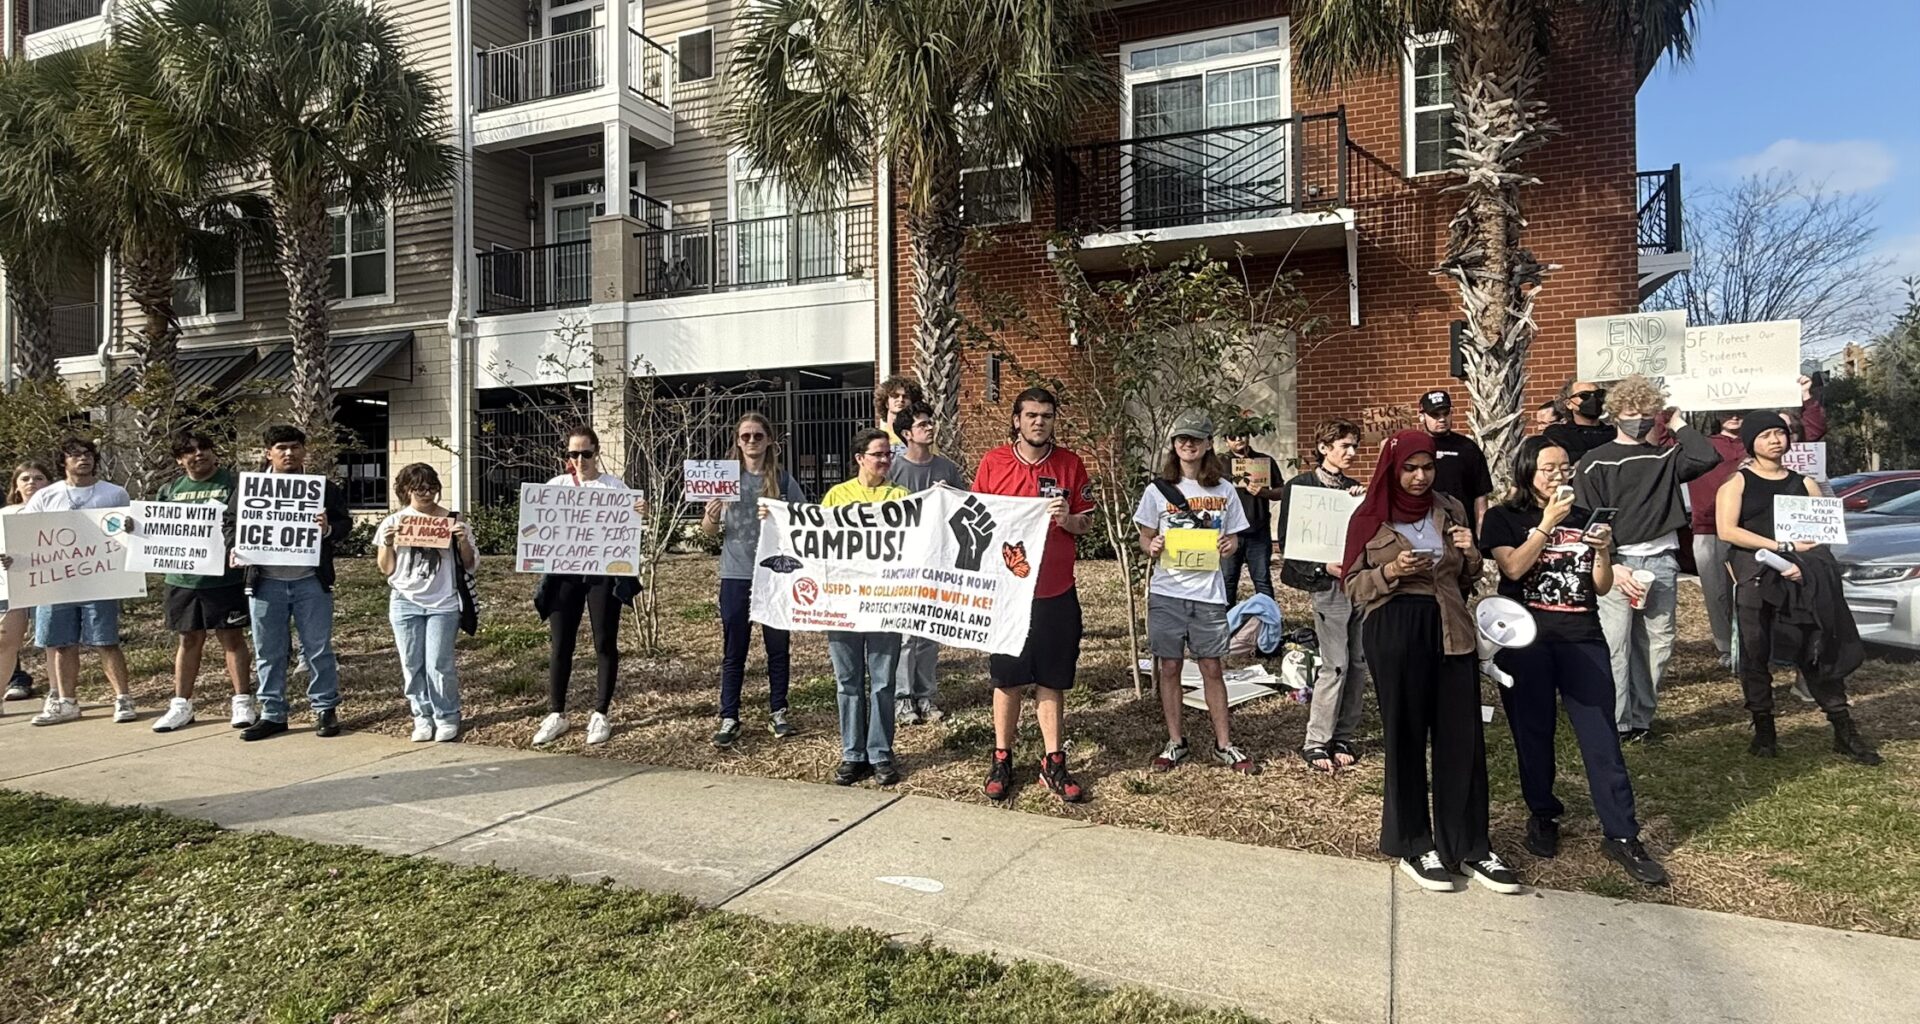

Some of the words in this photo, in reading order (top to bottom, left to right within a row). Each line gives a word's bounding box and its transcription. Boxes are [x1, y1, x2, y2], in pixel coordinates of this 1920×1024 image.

[1606, 317, 1667, 346] END
[1686, 331, 1707, 348] SF
[1717, 331, 1750, 345] Protect
[1759, 330, 1775, 340] Our
[1700, 350, 1747, 362] Students
[1732, 365, 1763, 375] Campus
[1707, 381, 1750, 399] NOW
[1371, 406, 1401, 420] FUCK
[1366, 418, 1413, 433] TRUMP
[695, 460, 722, 469] ICE
[1783, 453, 1817, 464] LLER
[714, 470, 729, 479] OF
[244, 477, 322, 500] HANDS
[685, 480, 741, 495] EVERYWHERE
[244, 498, 319, 511] OFF
[525, 488, 551, 505] WE
[556, 490, 585, 506] ARE
[589, 491, 642, 508] ALMOST
[1303, 494, 1344, 512] JAIL
[145, 505, 182, 519] STAND
[186, 507, 217, 520] WITH
[242, 510, 263, 519] OUR
[266, 511, 318, 523] STUDENTS
[535, 508, 557, 523] TO
[560, 508, 591, 523] THE
[595, 510, 630, 524] END
[787, 502, 825, 527] NO
[833, 501, 878, 528] ICE
[881, 497, 923, 528] ON
[1790, 513, 1841, 524] STUDENTS
[401, 516, 449, 528] CHINGA
[1776, 523, 1791, 532] NO
[1823, 526, 1838, 534] ON
[38, 528, 77, 547] NO
[143, 522, 214, 538] IMMIGRANT
[240, 525, 273, 545] ICE
[280, 526, 318, 547] OFF
[398, 525, 414, 536] LA
[539, 526, 560, 541] OF
[566, 526, 594, 541] THE
[1789, 532, 1836, 542] CAMPUS!
[144, 545, 187, 557] WORKERS
[189, 547, 208, 558] AND
[262, 546, 316, 554] CAMPUSES
[522, 543, 555, 558] THEY
[555, 544, 599, 558] CAME
[790, 529, 906, 562] CAMPUS!
[31, 545, 97, 567] HUMAN
[105, 541, 121, 554] IS
[1174, 550, 1206, 568] ICE
[153, 558, 195, 570] FAMILIES
[29, 559, 118, 587] ILLEGAL
[882, 568, 921, 580] SANCTUARY
[922, 568, 964, 586] CAMPUS
[966, 576, 996, 591] NOW!
[822, 583, 851, 595] USFPD
[859, 585, 872, 596] NO
[873, 585, 938, 600] COLLABORATION
[941, 588, 969, 604] WITH
[972, 595, 994, 610] ICE!
[968, 614, 992, 628] AND
[929, 622, 989, 644] STUDENTS!
